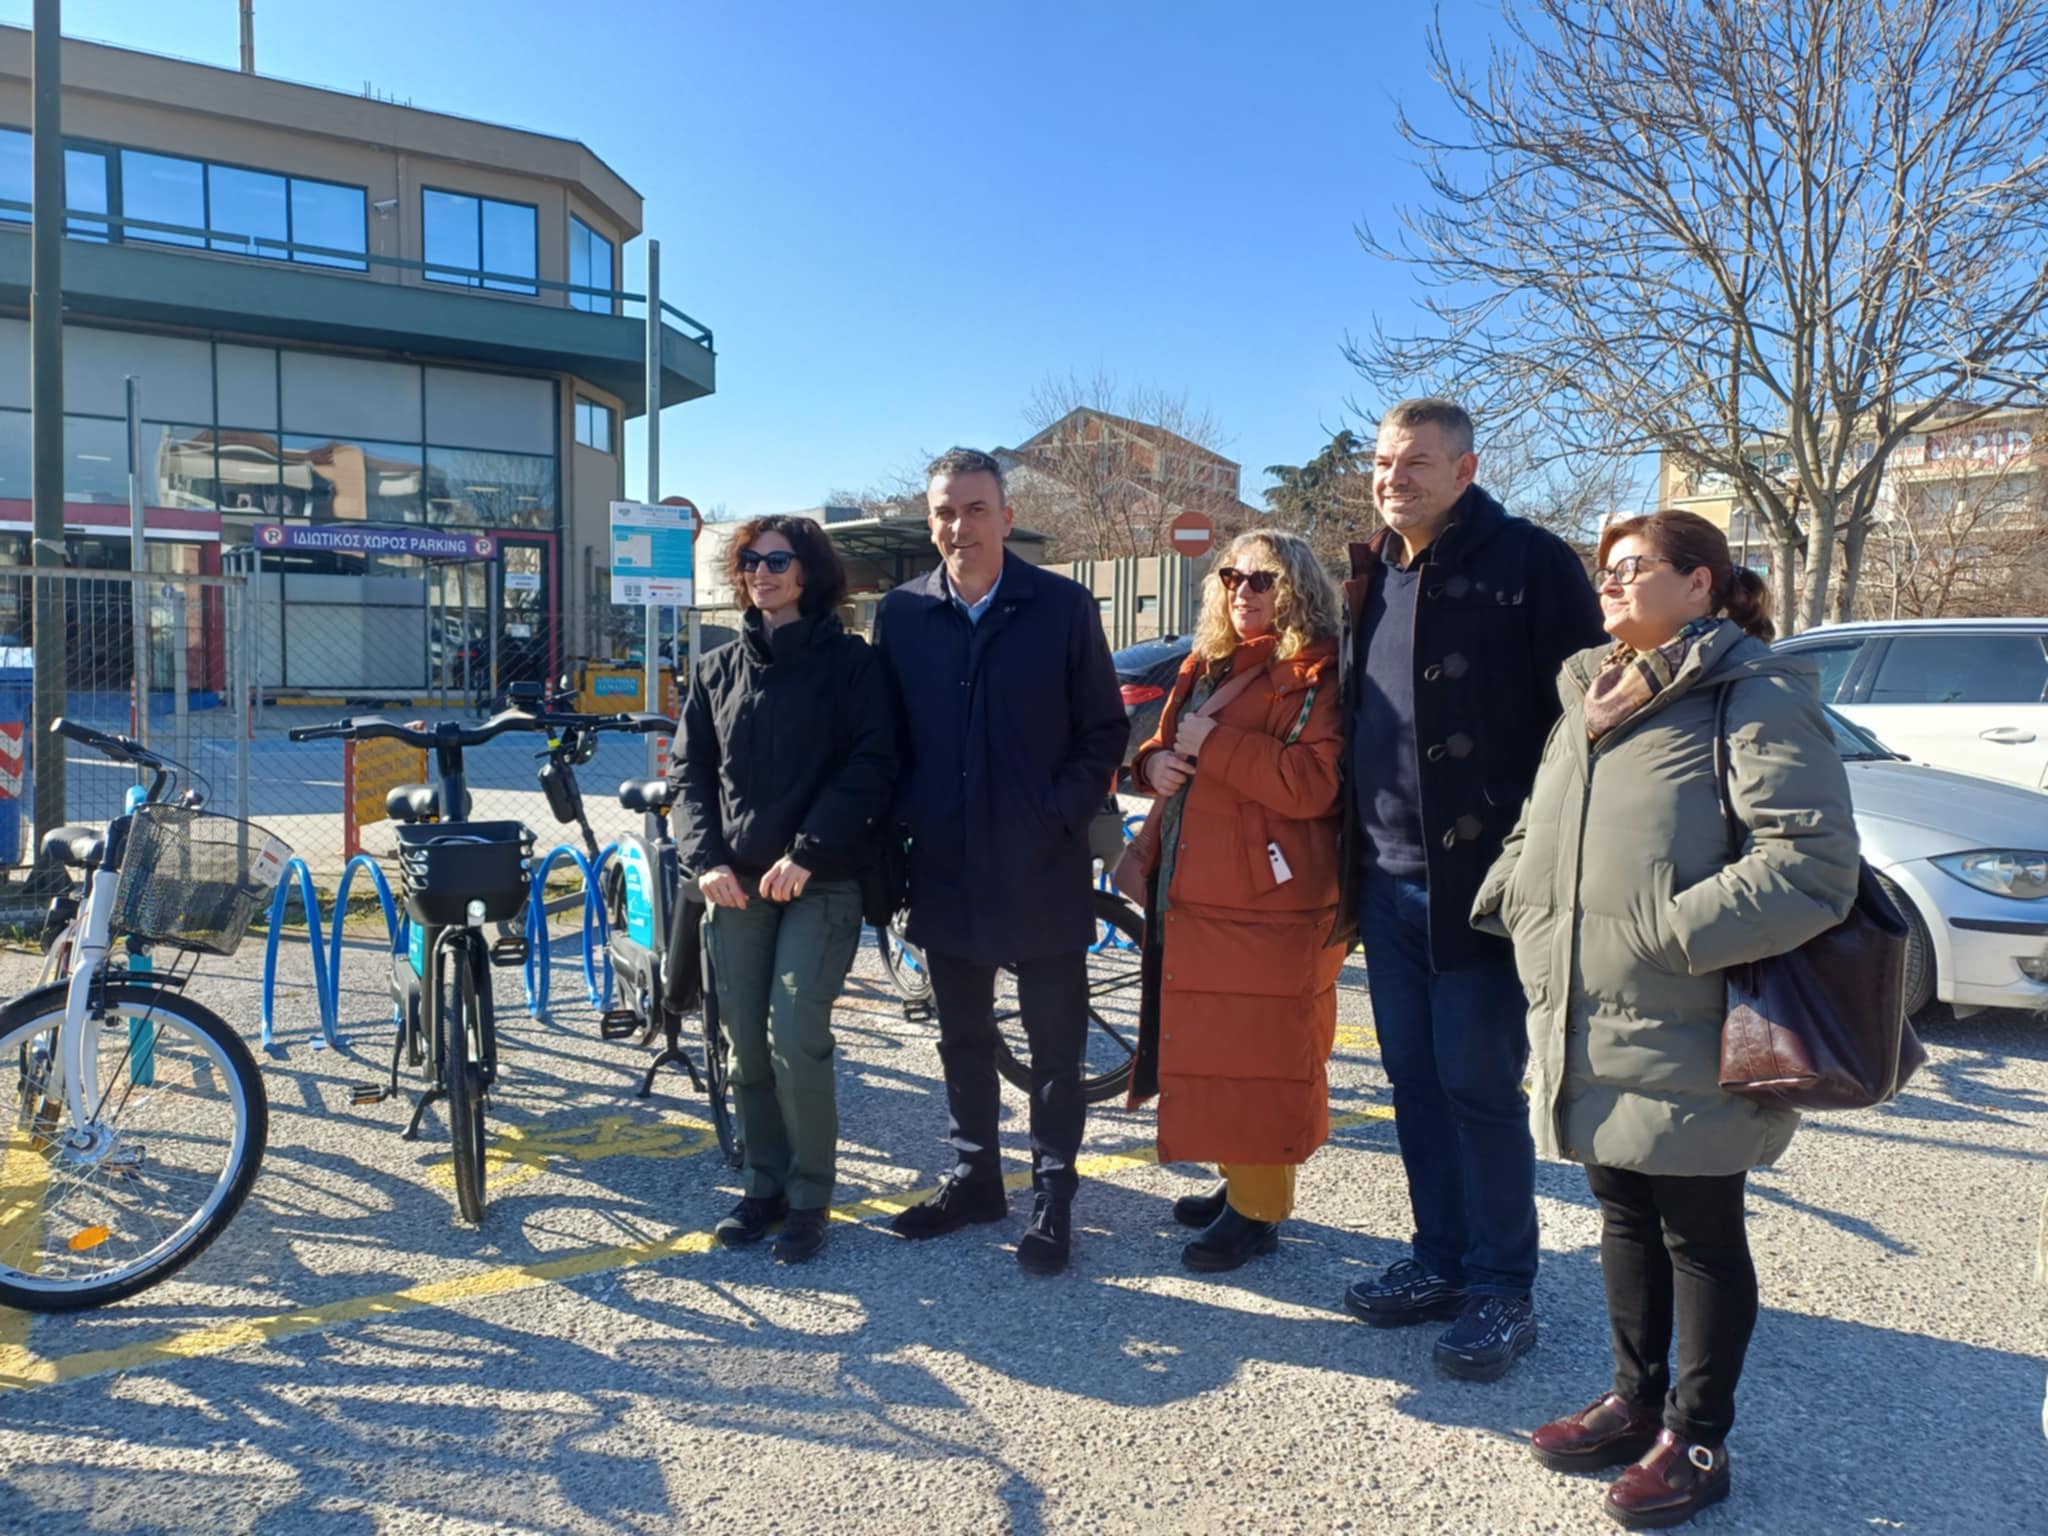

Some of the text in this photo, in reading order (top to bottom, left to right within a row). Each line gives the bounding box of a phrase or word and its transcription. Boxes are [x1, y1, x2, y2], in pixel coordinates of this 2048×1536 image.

[293, 531, 467, 553] ΙΔΙΩΤΙΚΟΣ ΧΩΡΟΣ PARKING
